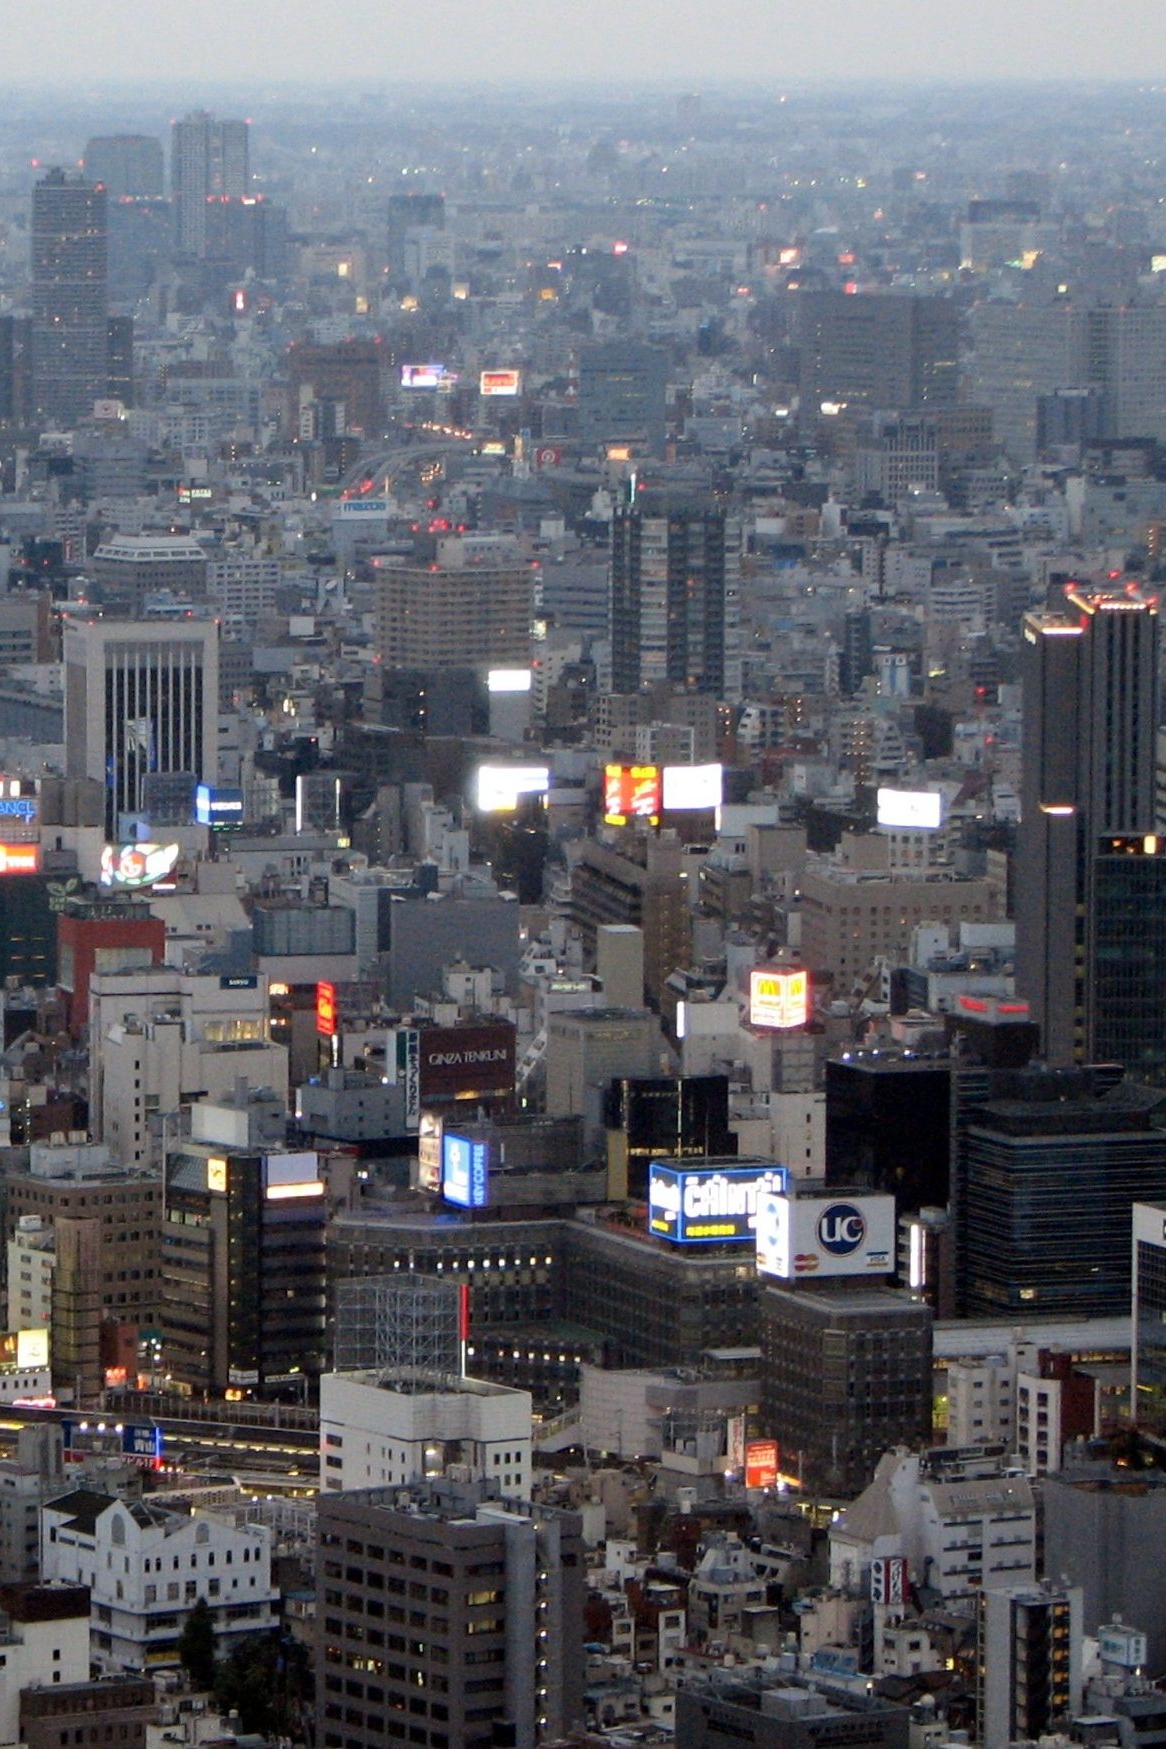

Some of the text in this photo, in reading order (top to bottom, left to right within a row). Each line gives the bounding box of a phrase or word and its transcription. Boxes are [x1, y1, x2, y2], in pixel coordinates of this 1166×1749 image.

[344, 501, 386, 511] mazda
[429, 1049, 507, 1066] GINZA TENKUNI
[473, 1143, 484, 1181] COFFEE
[821, 1216, 863, 1243] UC
